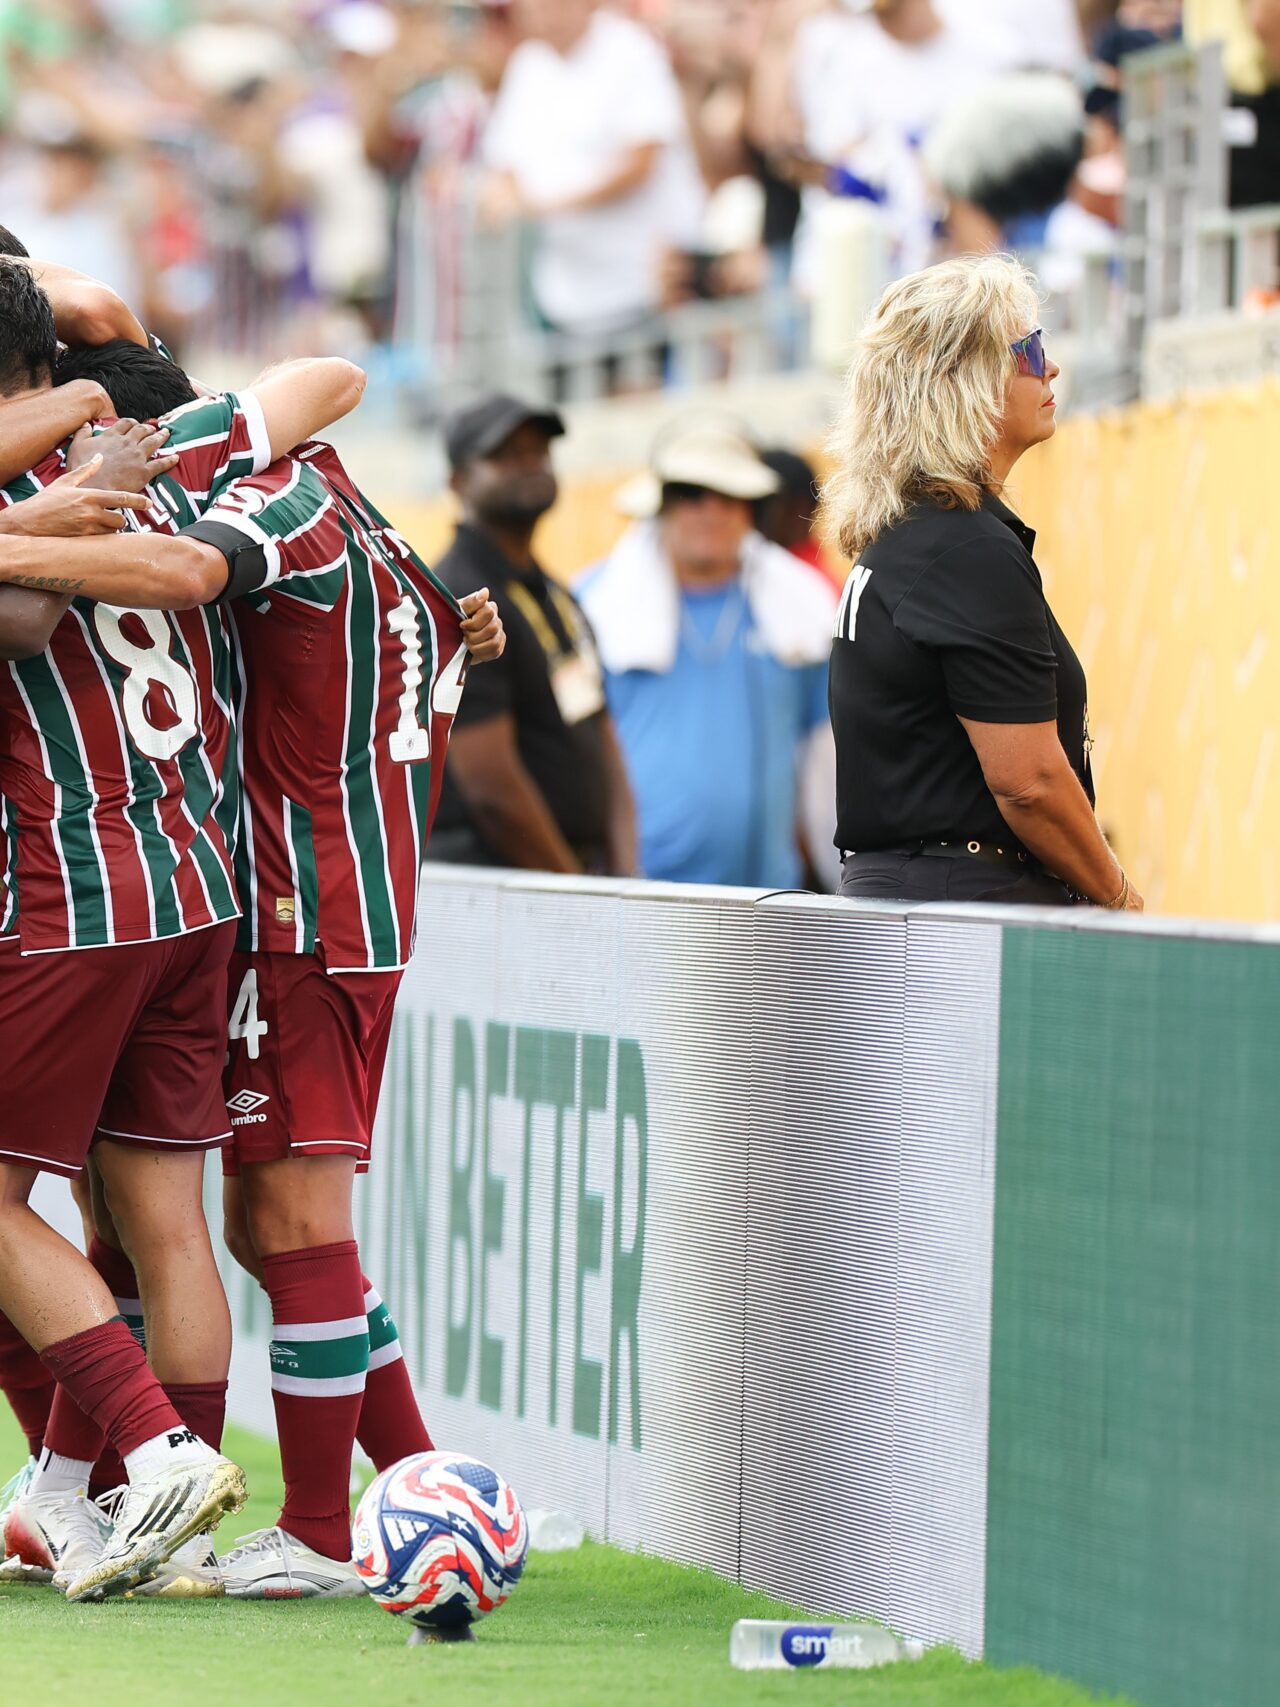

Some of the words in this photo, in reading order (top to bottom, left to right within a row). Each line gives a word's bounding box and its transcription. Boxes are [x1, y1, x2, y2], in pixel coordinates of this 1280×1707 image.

[94, 602, 198, 760] 8
[224, 968, 268, 1066] 4
[231, 1113, 267, 1126] umbro
[446, 1016, 648, 1452] BETTER
[791, 1634, 863, 1656] smart
